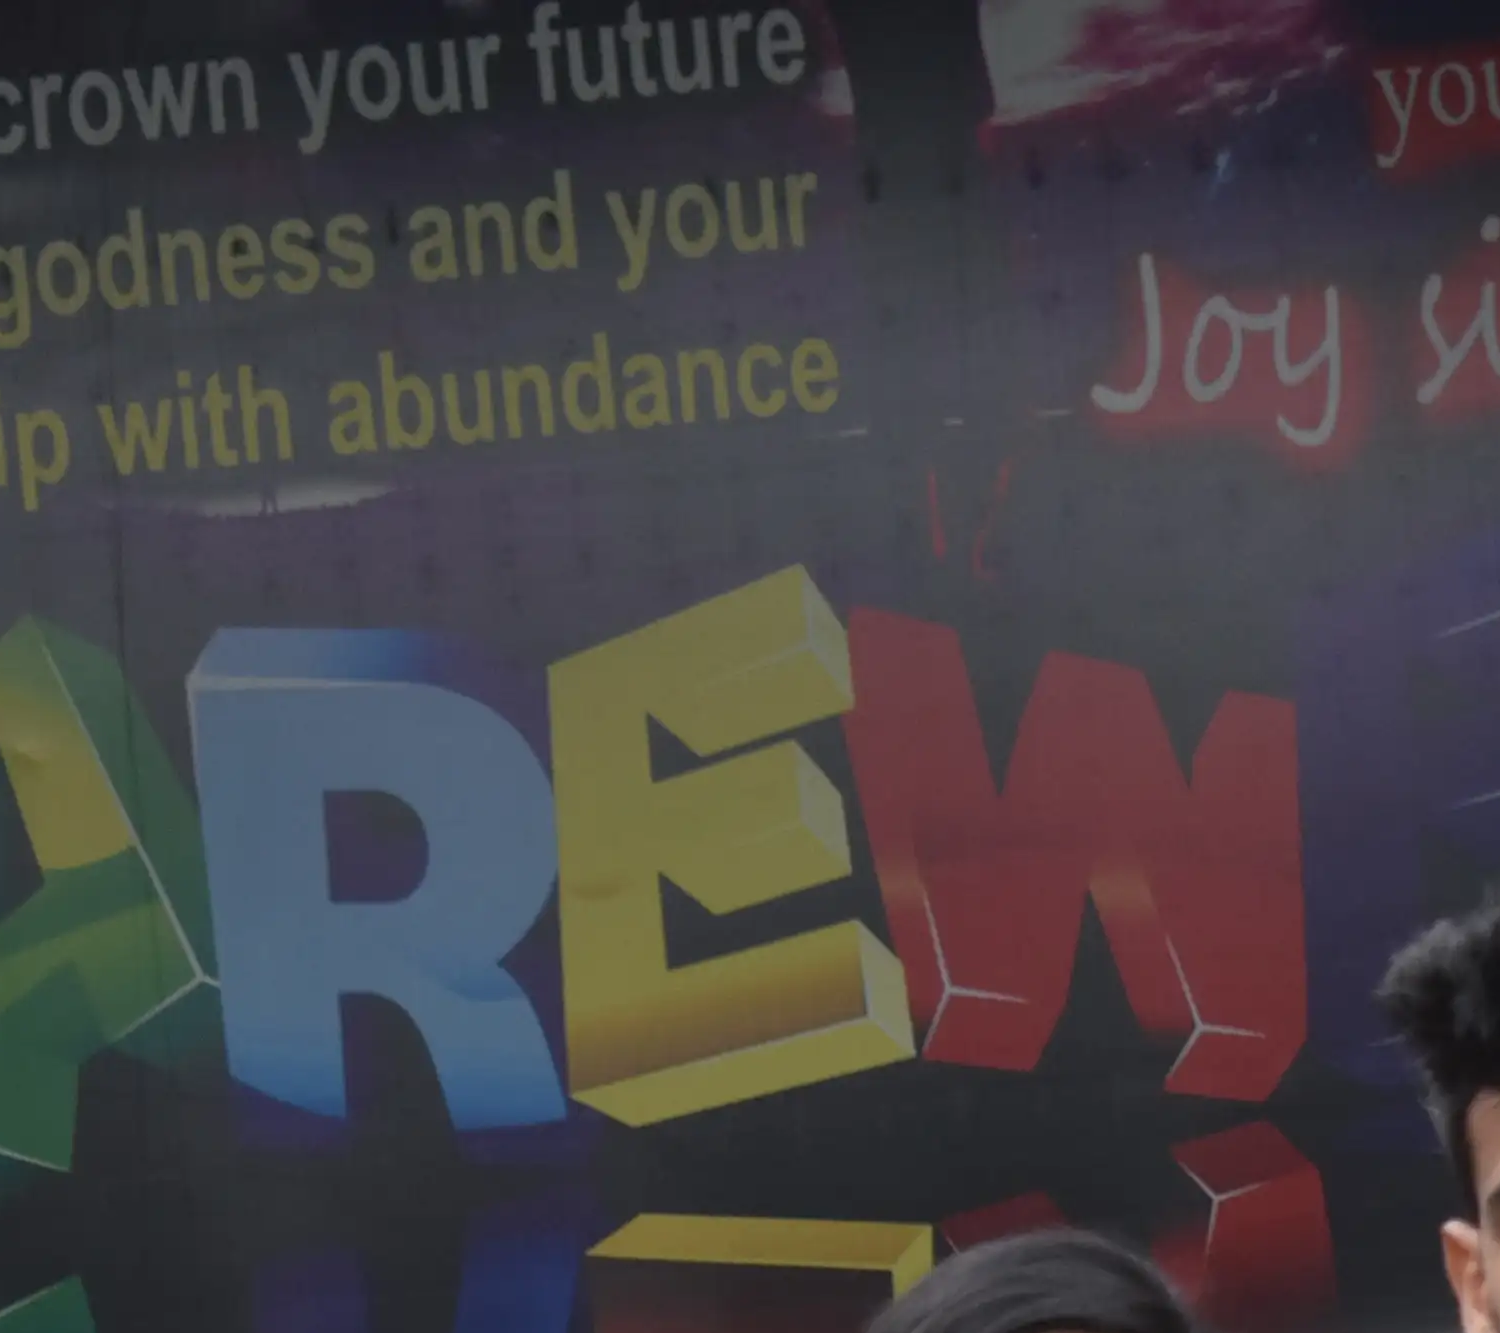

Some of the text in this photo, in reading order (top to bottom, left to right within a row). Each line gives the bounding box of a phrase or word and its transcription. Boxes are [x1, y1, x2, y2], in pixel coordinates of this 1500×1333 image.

[288, 31, 501, 155] your
[526, 1, 806, 105] future
[408, 168, 578, 283] and
[607, 172, 818, 292] your
[99, 364, 293, 476] with
[328, 332, 839, 455] abundance
[1090, 253, 1341, 446] Joy
